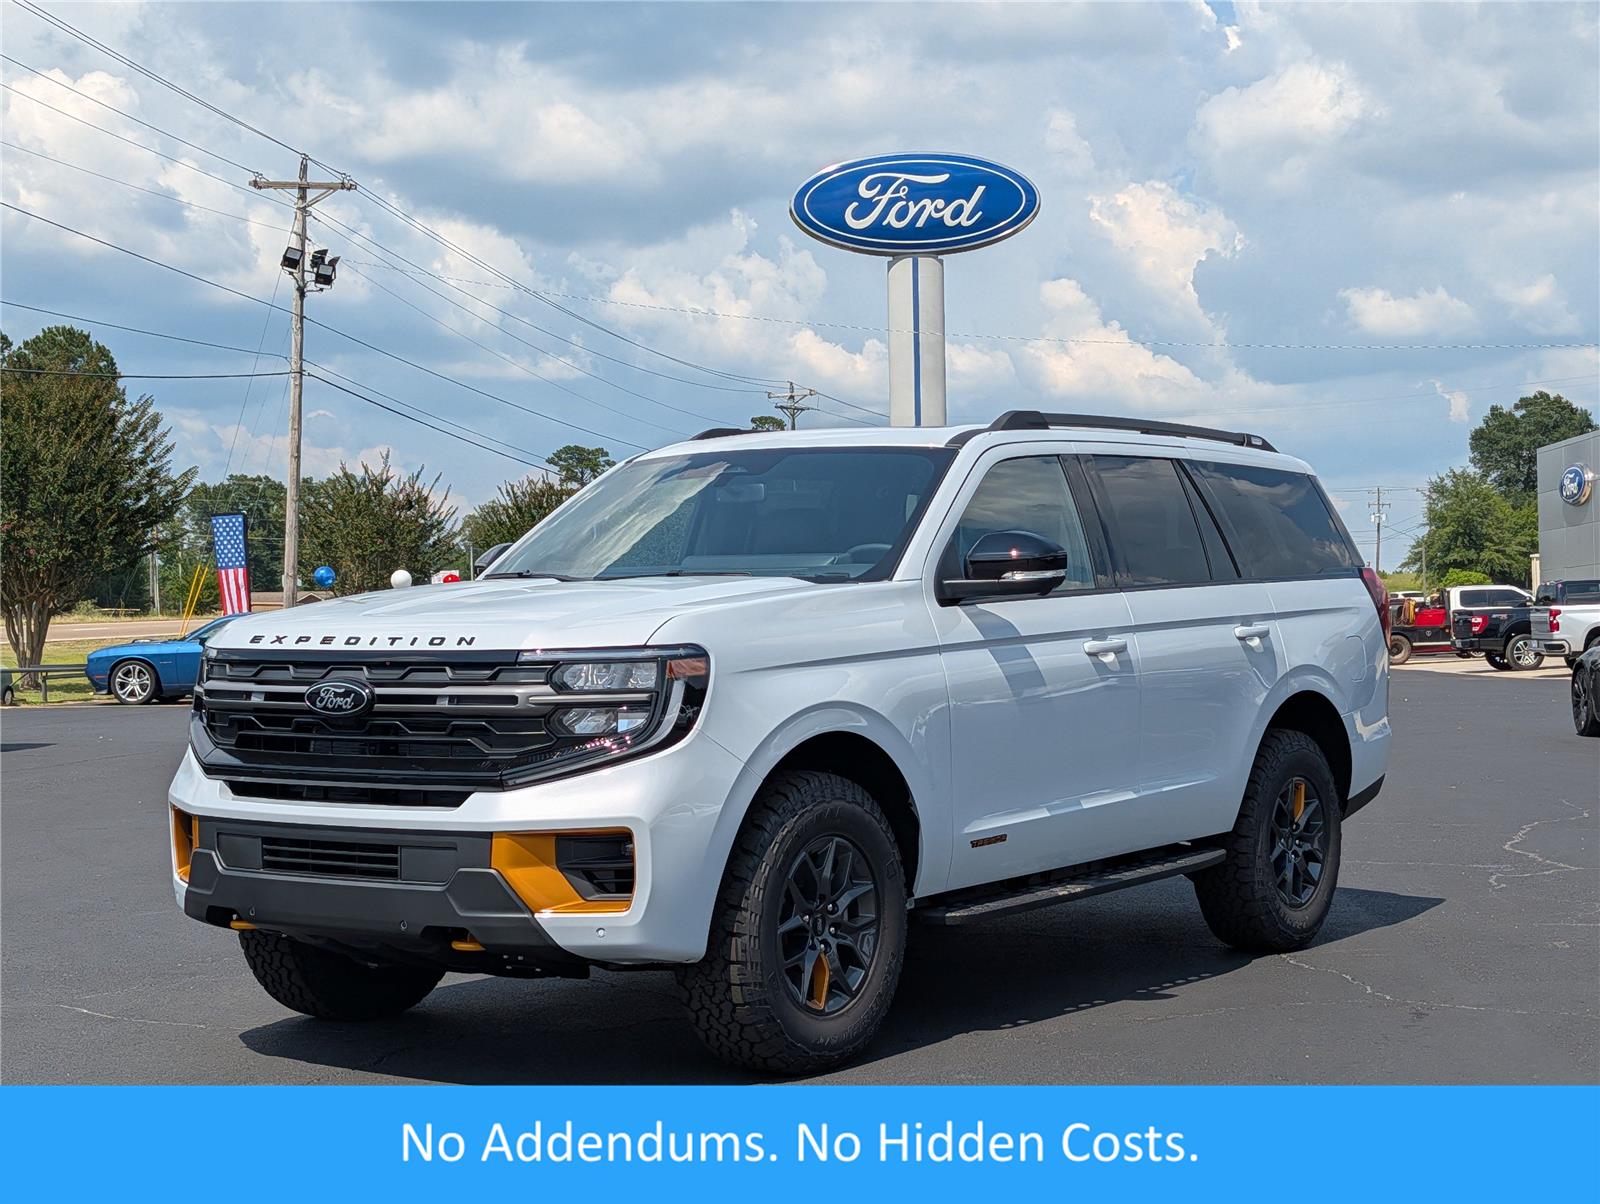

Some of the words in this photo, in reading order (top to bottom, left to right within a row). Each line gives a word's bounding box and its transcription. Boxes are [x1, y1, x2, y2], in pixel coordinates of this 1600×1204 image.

[844, 172, 986, 229] Ford
[1563, 472, 1579, 498] Ford
[249, 635, 477, 647] EXPEDITION
[315, 686, 354, 709] Ford
